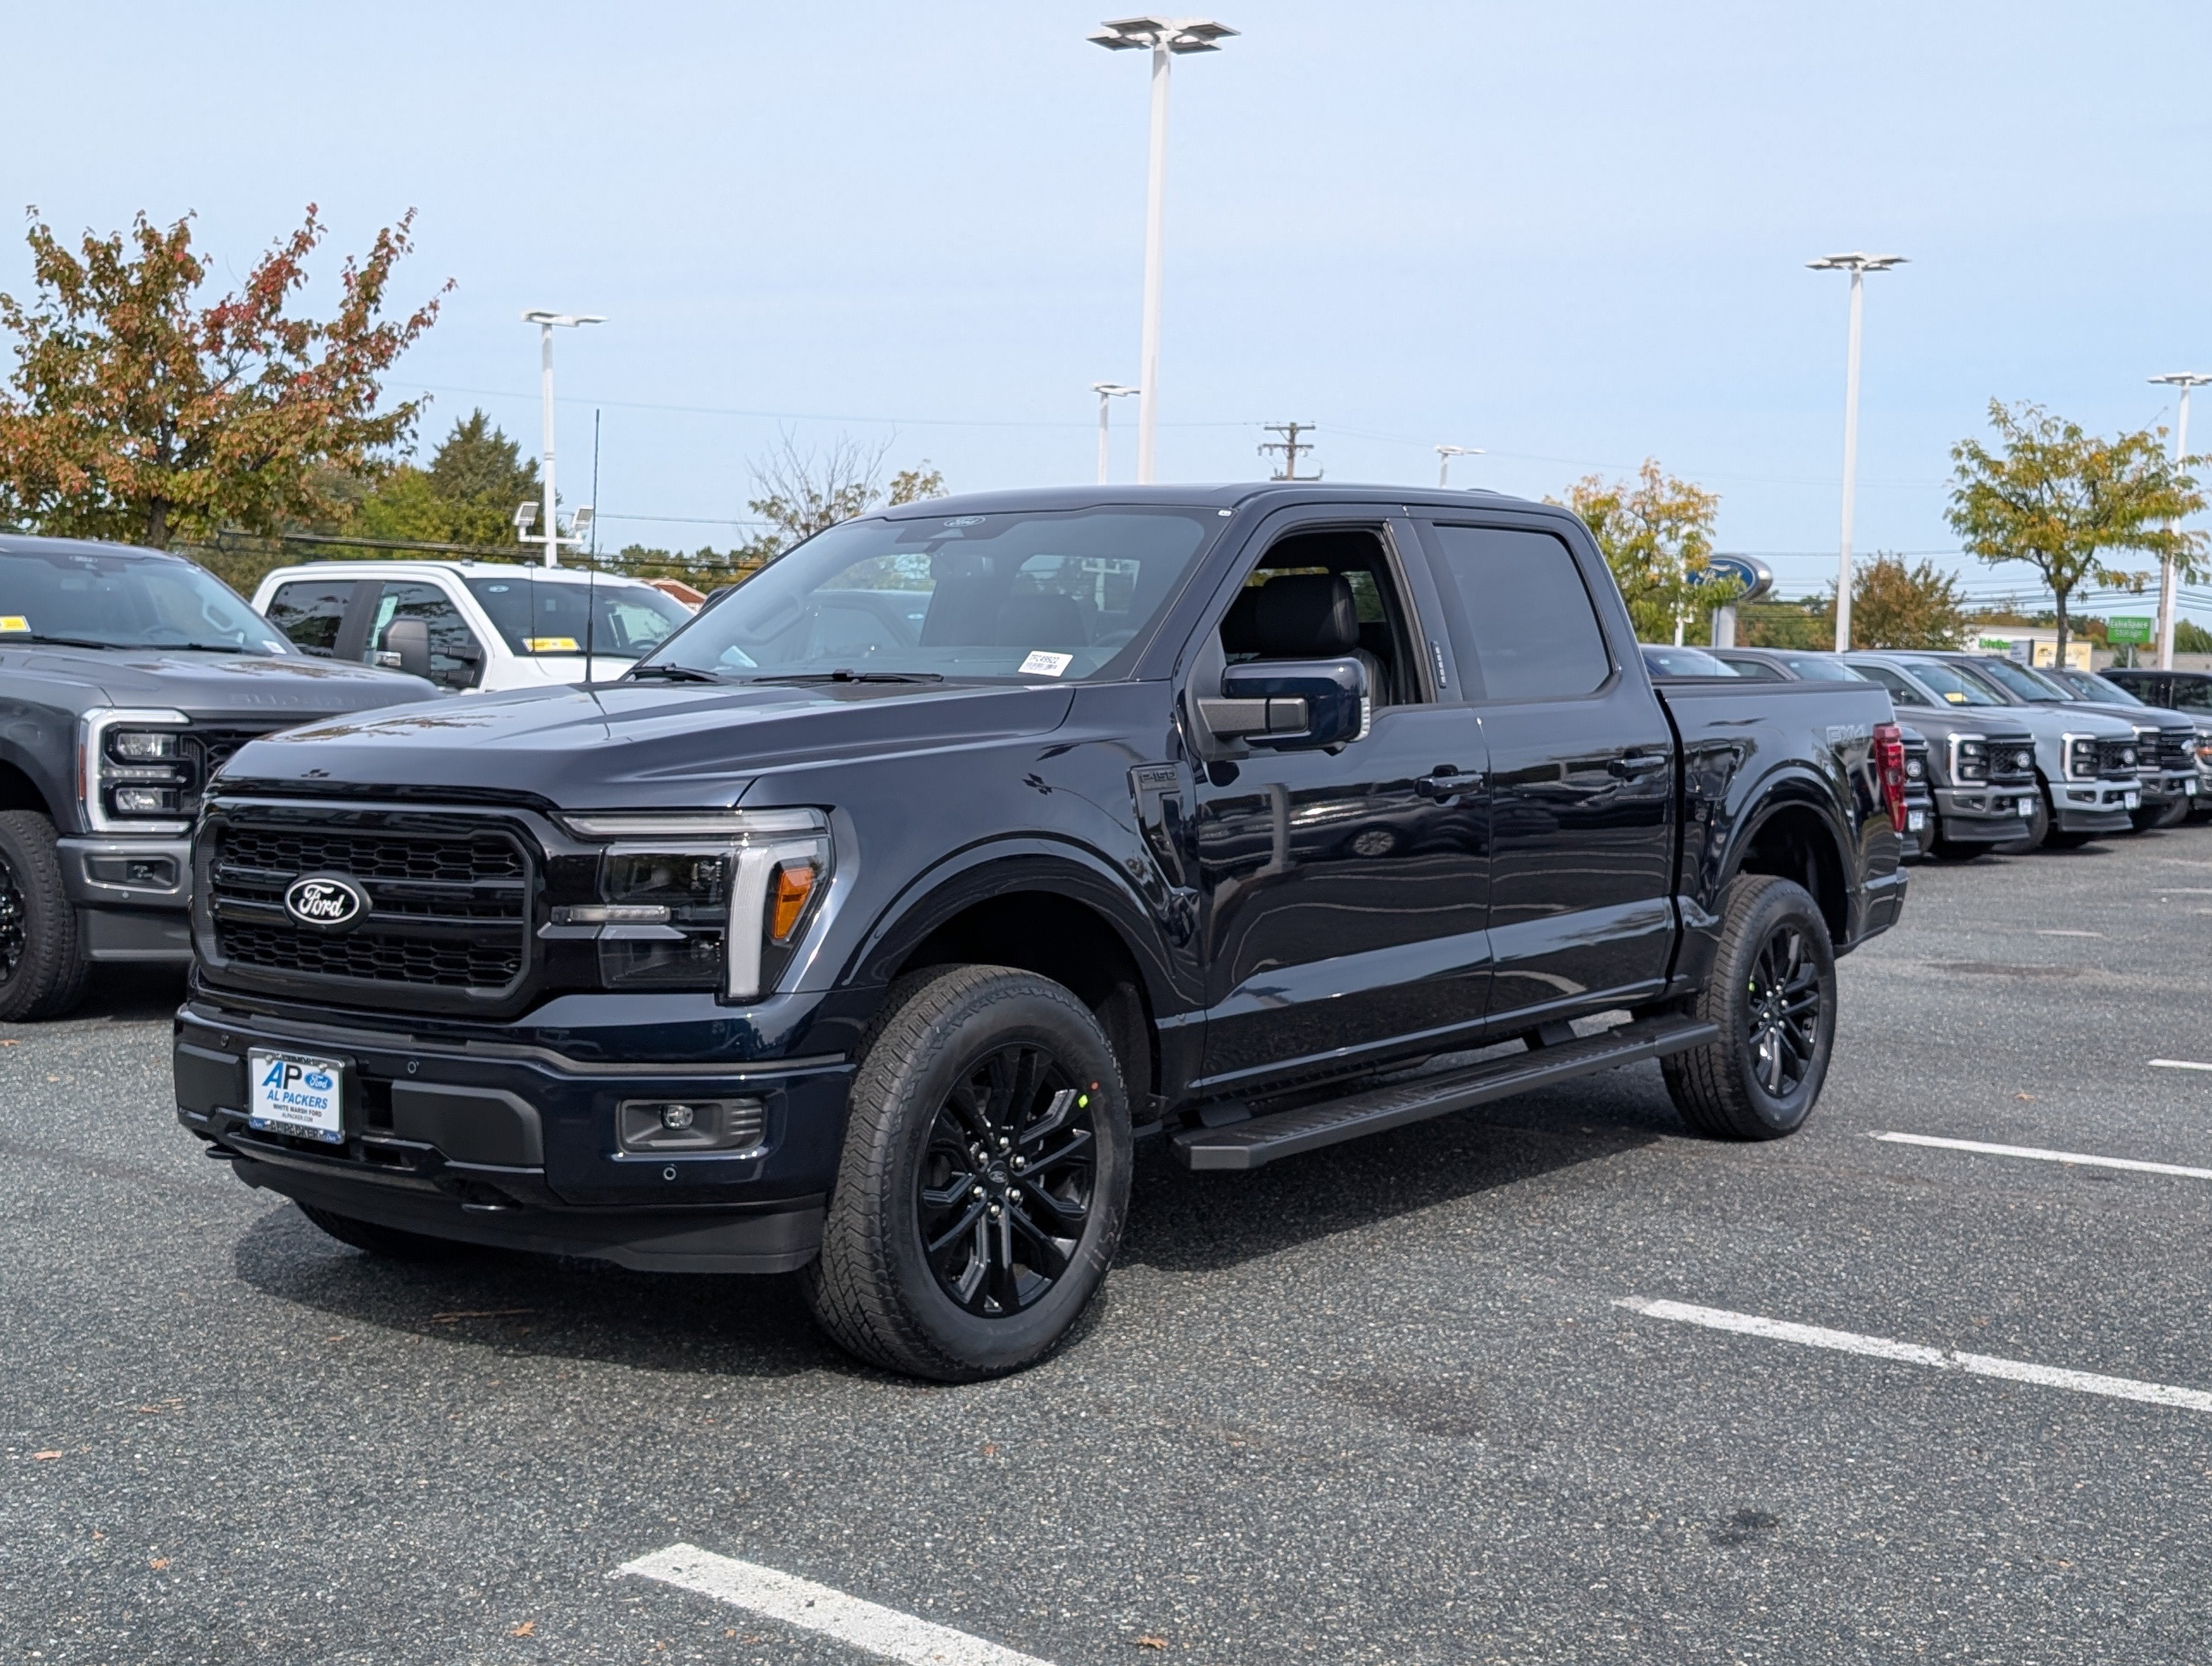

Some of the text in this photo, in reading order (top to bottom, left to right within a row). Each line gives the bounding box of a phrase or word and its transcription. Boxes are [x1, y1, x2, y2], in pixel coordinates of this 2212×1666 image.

[299, 884, 345, 917] Ford
[262, 1061, 302, 1090] AP
[310, 1074, 329, 1090] Ford
[267, 1089, 328, 1110] AL PACKERS
[273, 1103, 322, 1117] WHITE MARSH FORD
